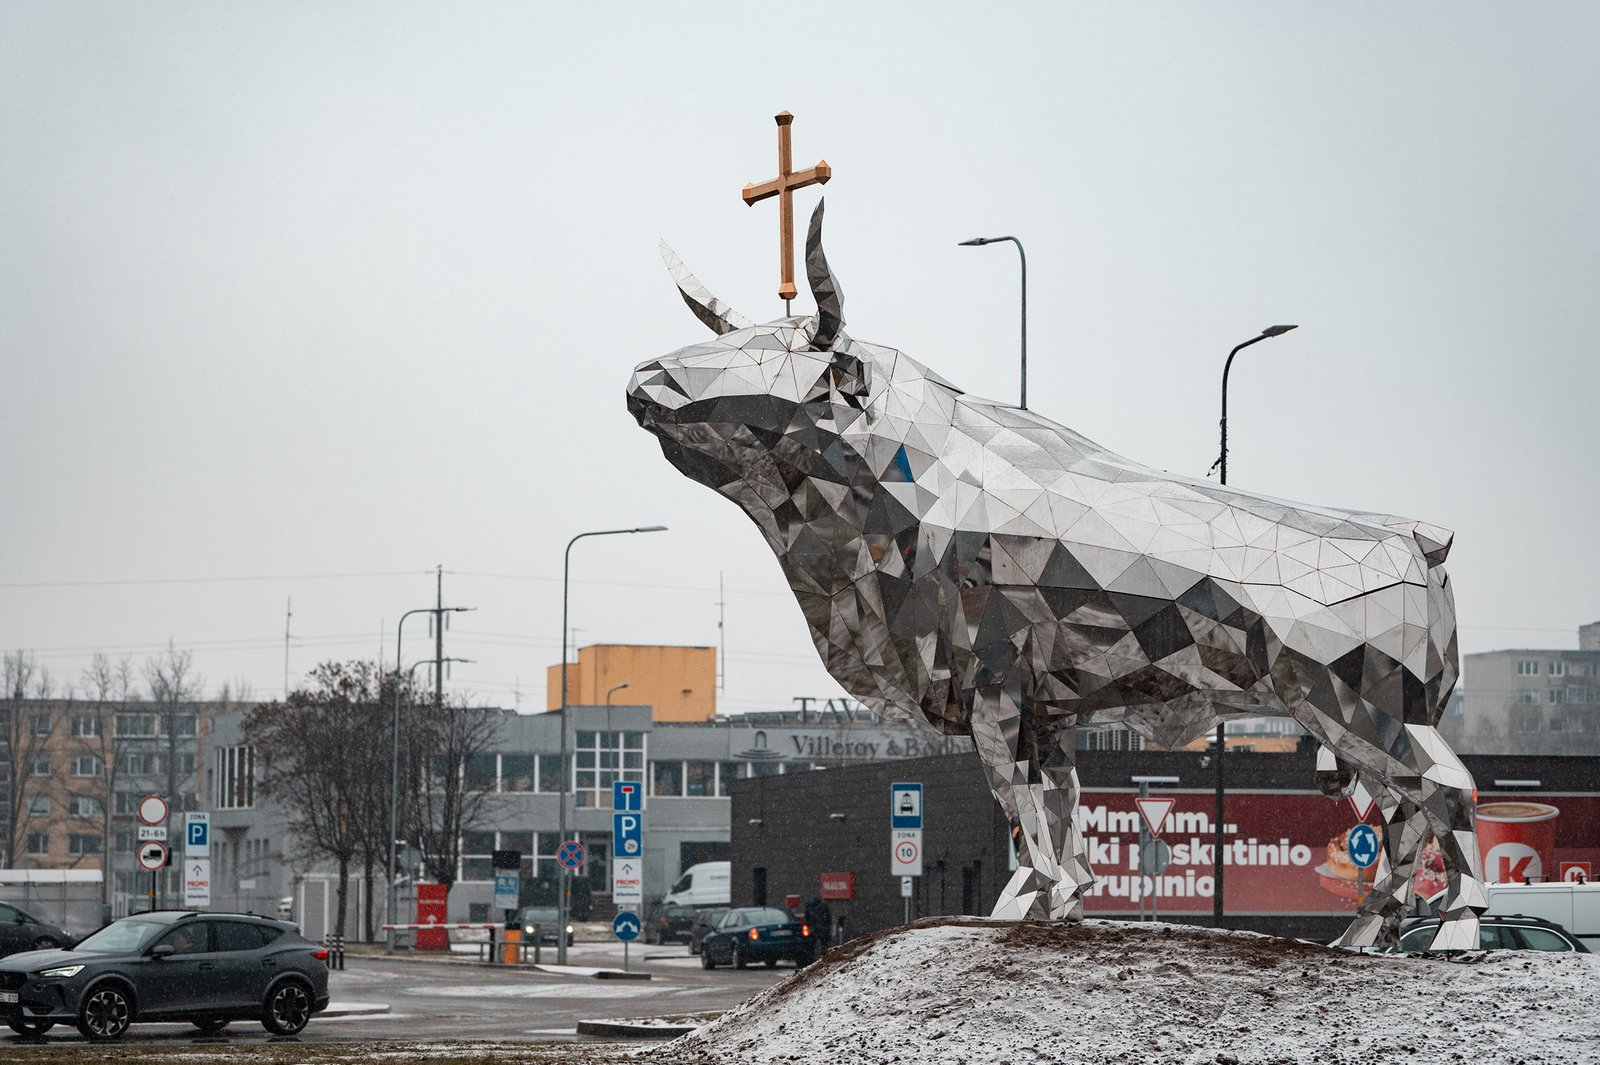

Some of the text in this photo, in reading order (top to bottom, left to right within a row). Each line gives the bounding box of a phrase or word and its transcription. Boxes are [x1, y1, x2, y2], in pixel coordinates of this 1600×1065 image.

[791, 735, 880, 761] Villeroy
[192, 825, 203, 843] P
[622, 816, 636, 838] P
[901, 848, 912, 857] 10
[1129, 838, 1312, 870] pskutinio
[1499, 856, 1534, 883] K
